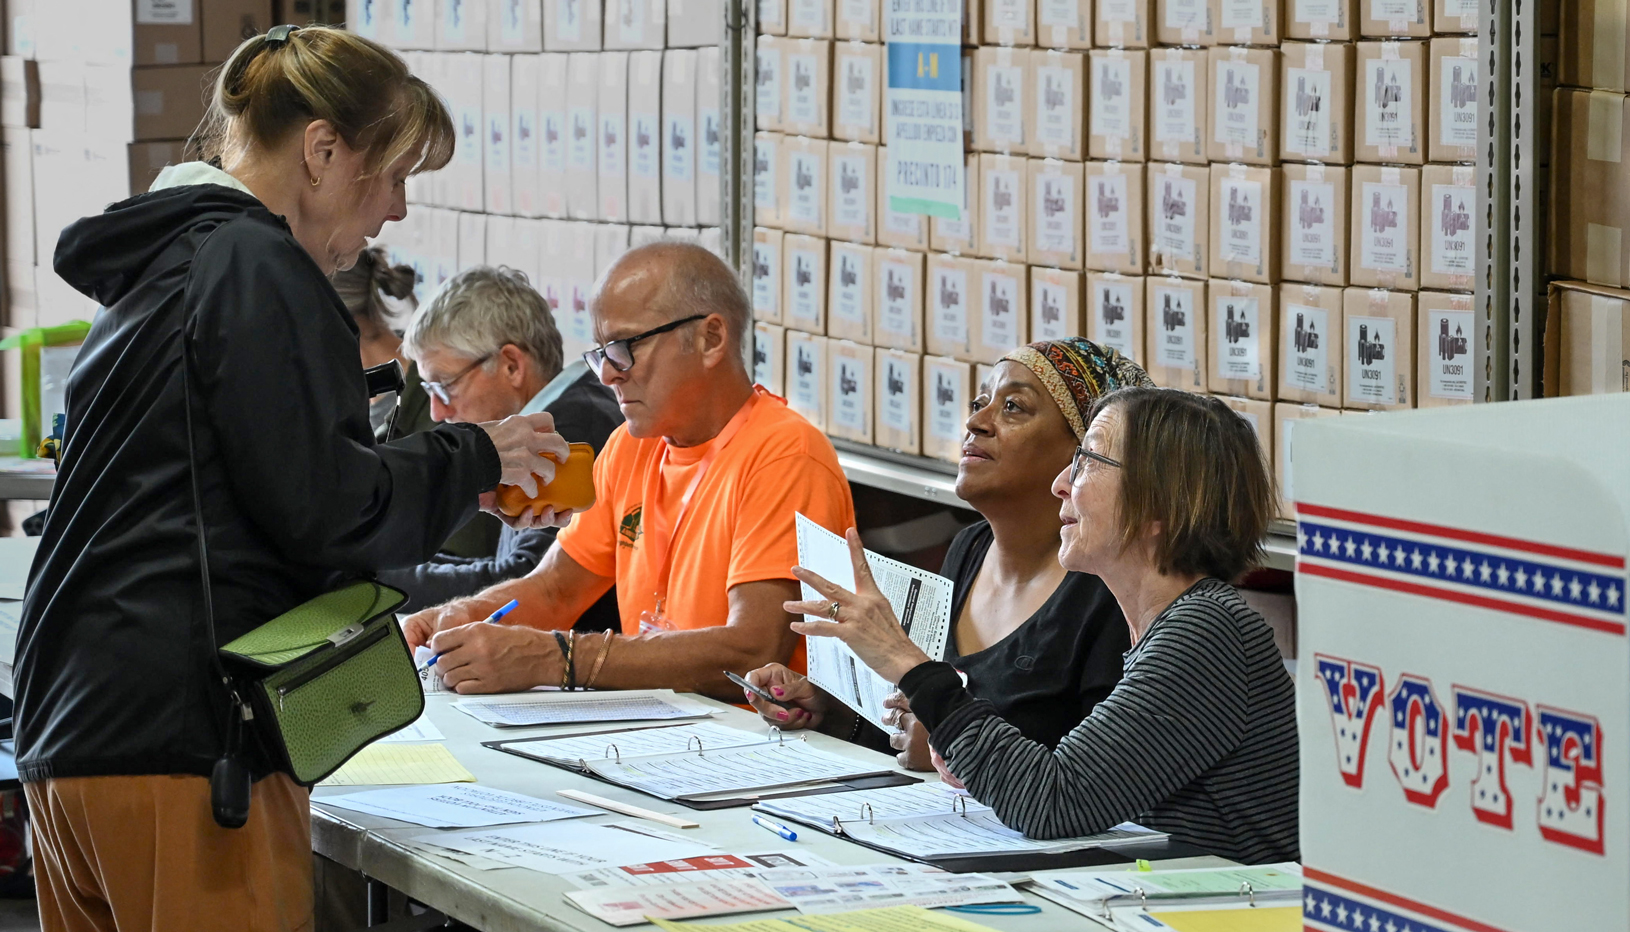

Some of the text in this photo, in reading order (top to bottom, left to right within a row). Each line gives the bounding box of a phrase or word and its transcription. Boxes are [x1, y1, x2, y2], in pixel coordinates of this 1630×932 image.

[891, 17, 906, 35] LAST
[909, 17, 923, 36] NAME
[1379, 111, 1398, 123] UN3091
[1454, 111, 1475, 123] UN3091
[897, 161, 957, 190] PRECINTO 174
[1374, 236, 1393, 247] UN3091
[1444, 239, 1465, 252] UN3091
[1297, 357, 1315, 369] UN3091
[1362, 369, 1381, 380] UN3091
[1443, 364, 1463, 375] UN3091
[1314, 652, 1605, 856] VOTE
